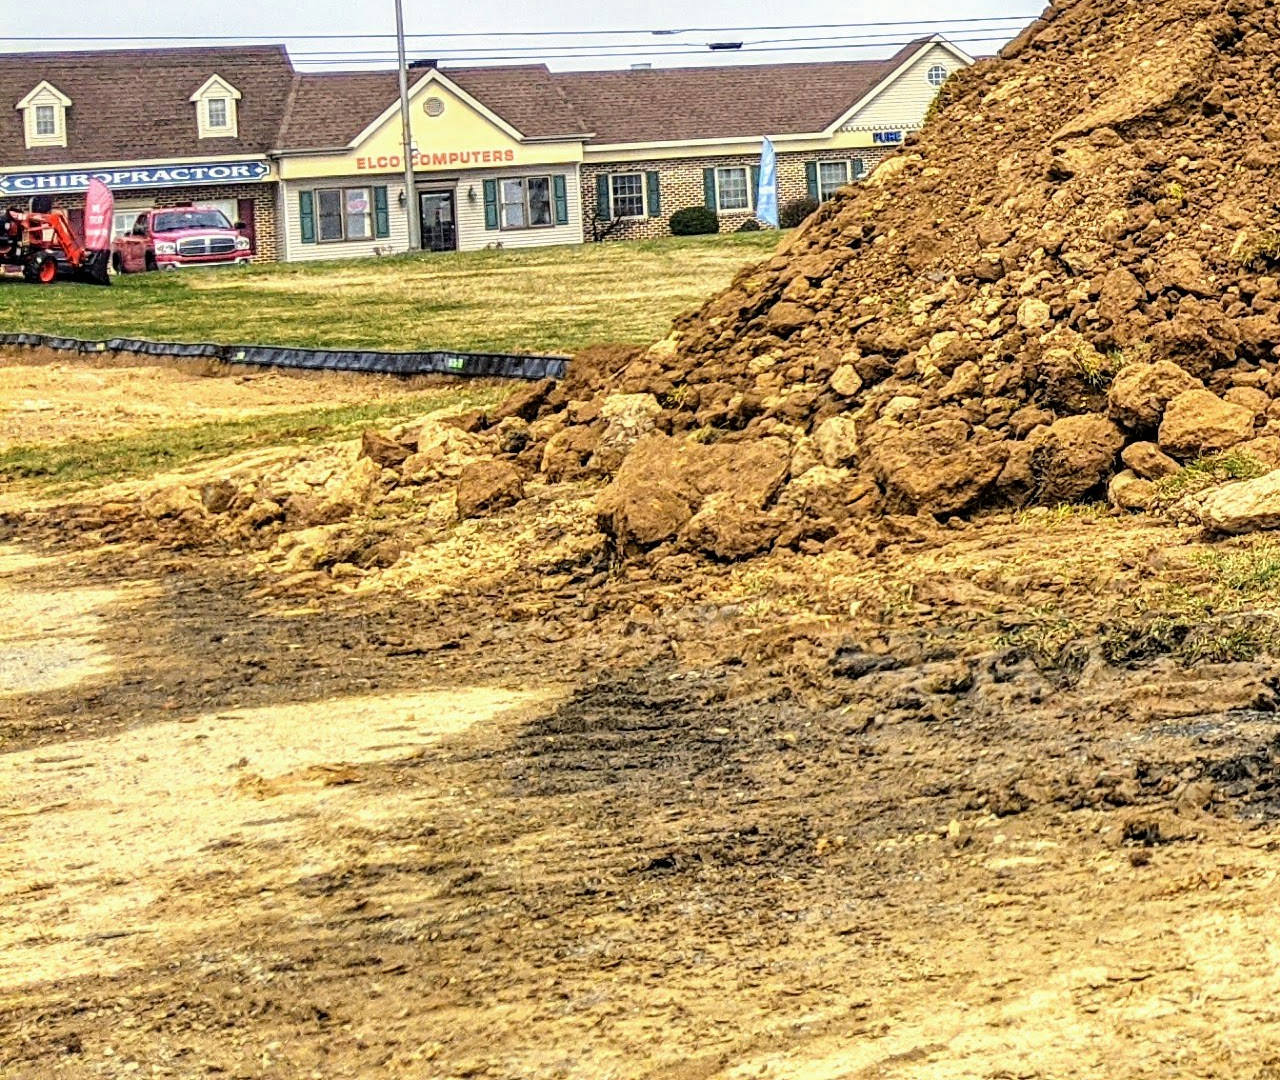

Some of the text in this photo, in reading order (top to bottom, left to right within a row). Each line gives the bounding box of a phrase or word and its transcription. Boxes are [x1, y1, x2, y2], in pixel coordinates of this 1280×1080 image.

[356, 149, 514, 170] ELCO COMPUTERS
[14, 164, 251, 189] CHIROPRACTOR
